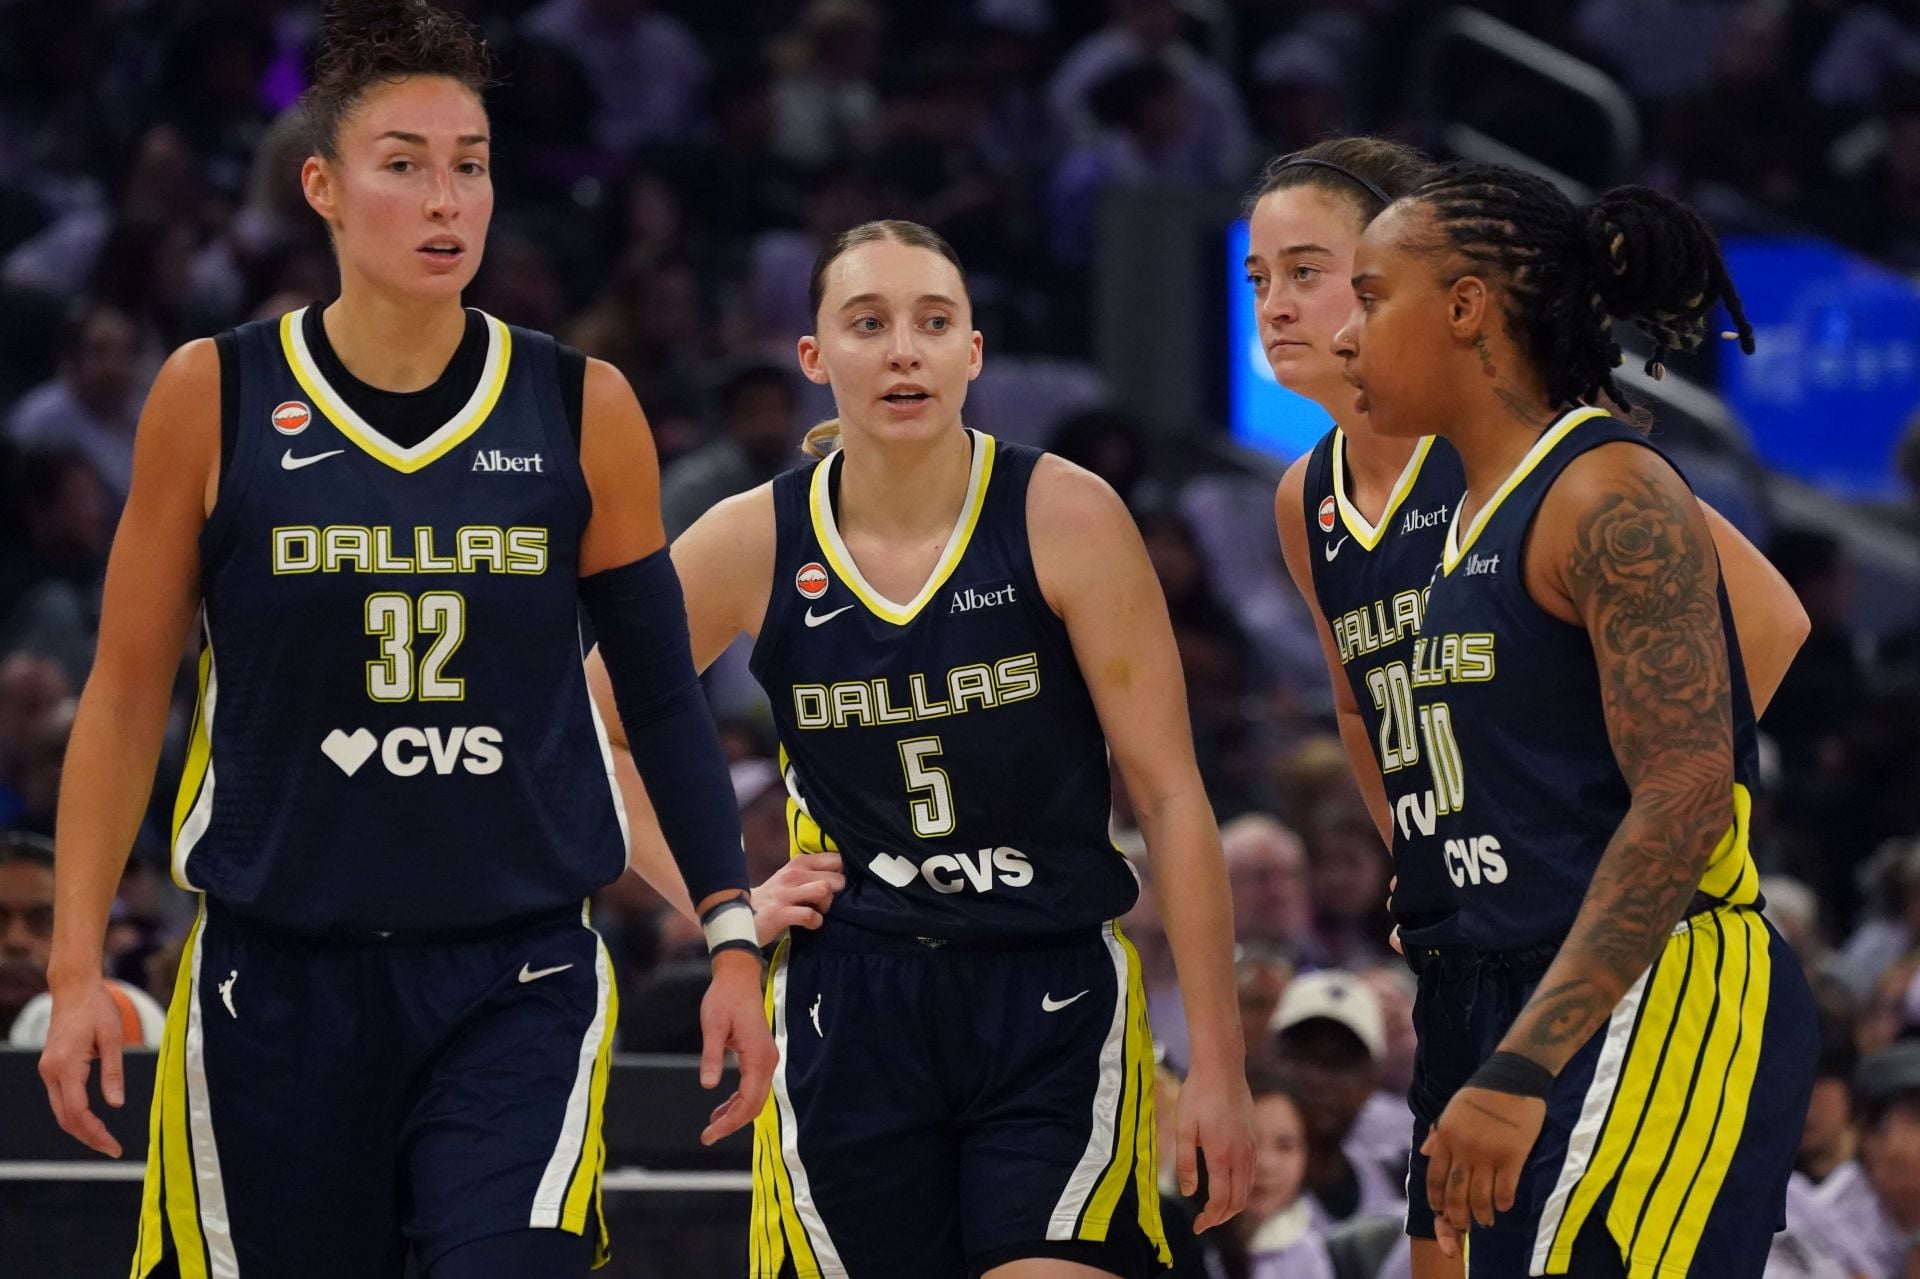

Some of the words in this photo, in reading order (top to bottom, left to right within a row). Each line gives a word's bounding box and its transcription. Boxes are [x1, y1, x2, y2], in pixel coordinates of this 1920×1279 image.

[471, 449, 543, 473] Albert
[1401, 504, 1448, 535] Albert
[272, 525, 548, 575] DALLAS
[949, 583, 1017, 614] Albert
[364, 590, 466, 703] 32
[1332, 585, 1431, 665] DALLA
[792, 652, 1041, 729] DALLAS
[1366, 661, 1419, 774] 20
[381, 726, 504, 777] CVS
[1419, 702, 1464, 815] 10
[897, 735, 956, 838] 5
[1396, 790, 1437, 841] CV
[920, 846, 1034, 894] CVS
[1443, 834, 1508, 888] CVS
